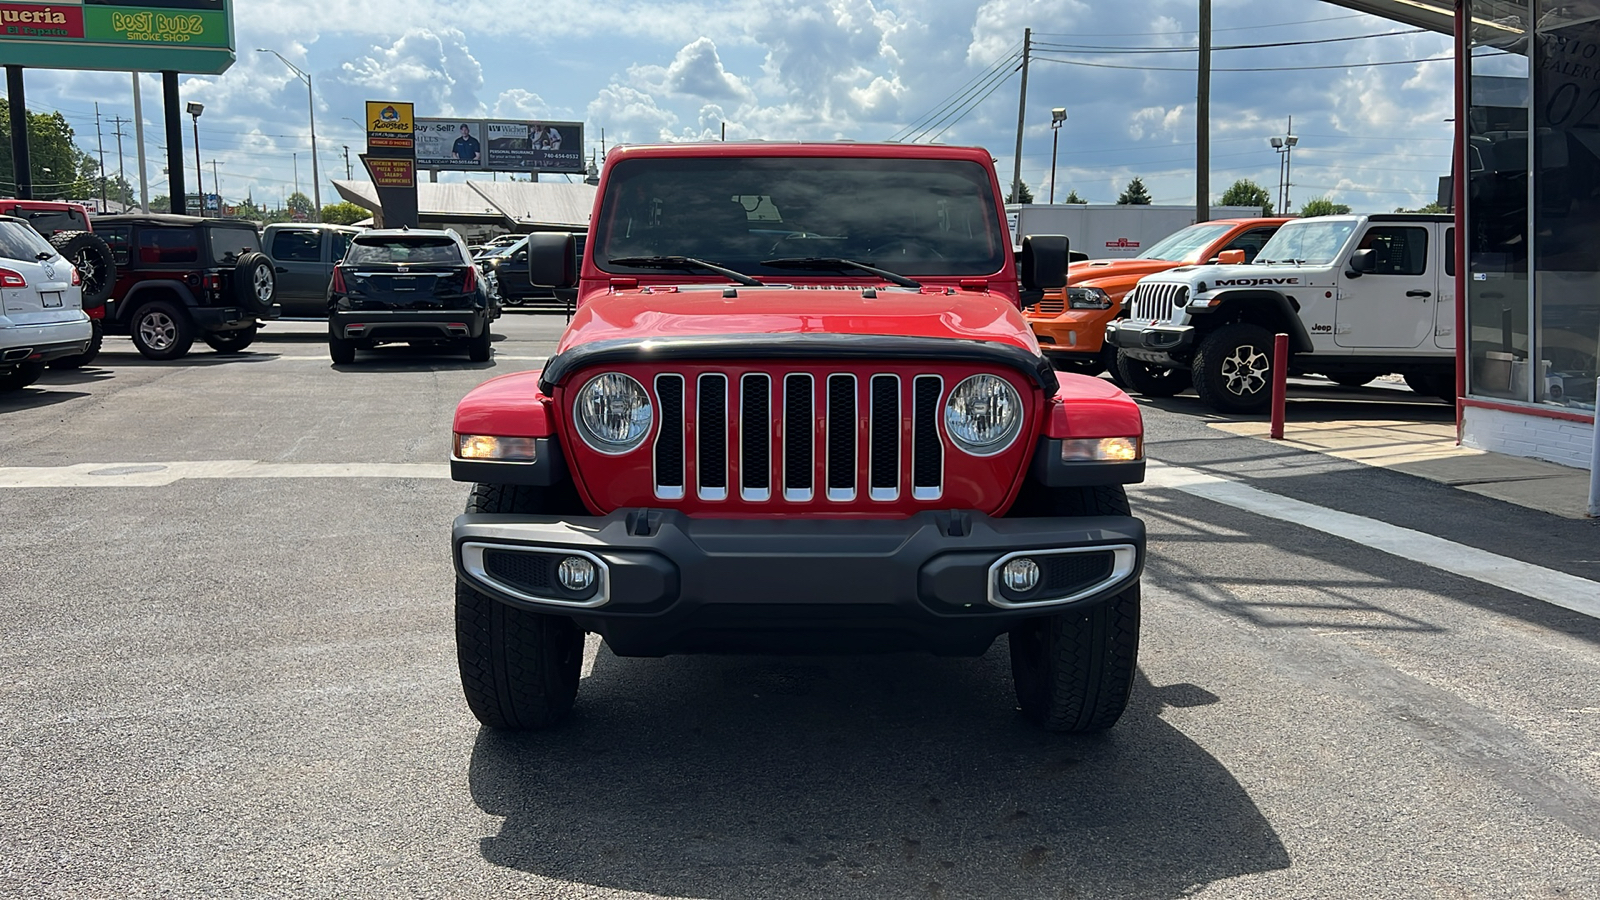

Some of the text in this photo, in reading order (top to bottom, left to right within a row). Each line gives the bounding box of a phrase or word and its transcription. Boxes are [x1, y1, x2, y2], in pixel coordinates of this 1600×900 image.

[0, 7, 67, 25] ueria
[7, 26, 19, 34] El
[126, 31, 190, 42] SMOKE SHOP
[1540, 57, 1592, 79] EALER
[372, 119, 409, 131] Roosters
[414, 123, 428, 132] Buy
[436, 124, 456, 132] Sell?
[1215, 277, 1299, 287] MOJAVE
[1311, 323, 1332, 332] Jeep
